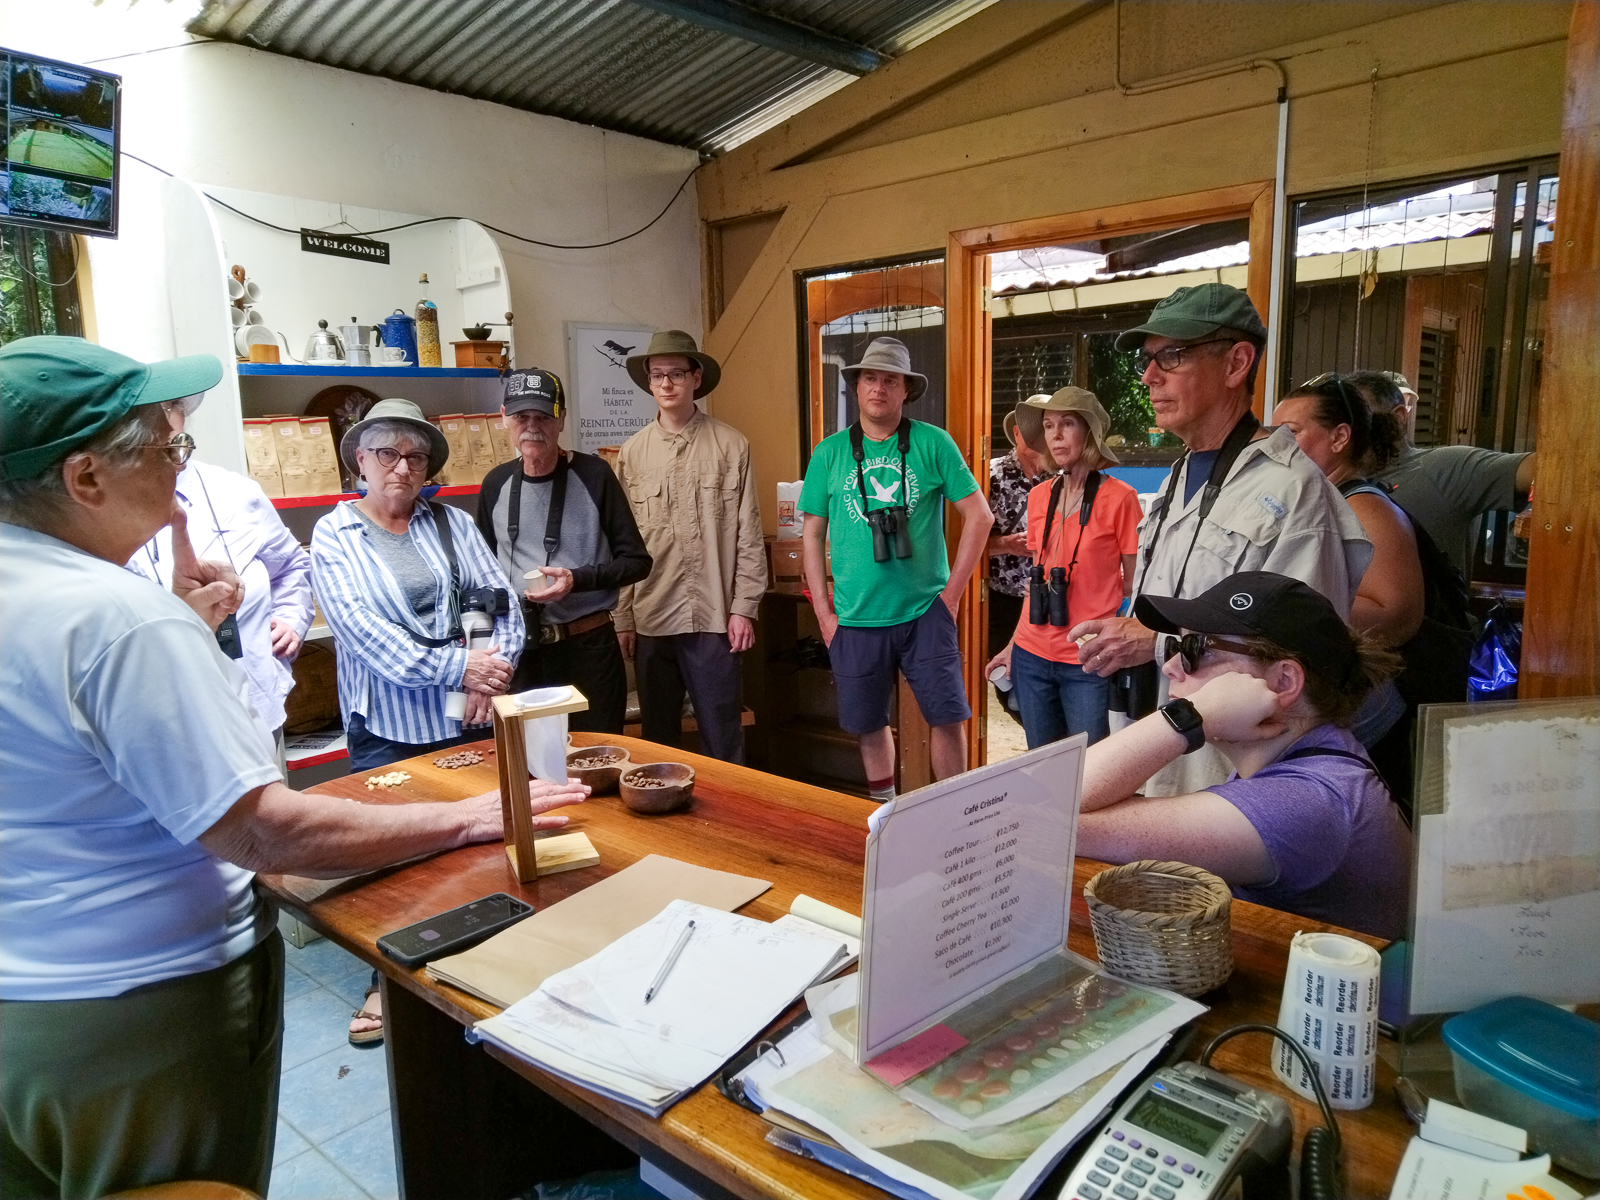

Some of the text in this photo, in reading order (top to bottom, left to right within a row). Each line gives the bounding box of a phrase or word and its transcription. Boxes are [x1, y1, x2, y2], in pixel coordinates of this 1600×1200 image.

[306, 236, 386, 257] WELCOME
[602, 387, 610, 395] Mi
[611, 387, 626, 395] finca
[603, 398, 633, 407] HÁBITAT
[580, 418, 616, 428] REINITA
[585, 430, 593, 438] de
[843, 493, 861, 524] LONG
[865, 455, 889, 466] BIRD
[964, 803, 979, 815] Café
[944, 846, 965, 859] Coffee
[965, 839, 980, 850] Tour
[944, 863, 959, 875] Café
[960, 860, 964, 868] 1
[964, 856, 976, 866] kilo
[943, 878, 957, 891] Café
[957, 873, 969, 885] 400
[969, 869, 982, 881] gms
[941, 895, 956, 908] Café
[956, 889, 968, 902] 200
[967, 885, 981, 897] gms
[942, 909, 960, 923] Single
[960, 901, 977, 915] Serve
[935, 927, 956, 942] Coffee
[956, 917, 976, 931] Cherry
[976, 912, 988, 921] Tea
[934, 946, 949, 959] Saco
[949, 941, 957, 951] de
[958, 933, 972, 946] Café
[945, 949, 974, 969] Chocolate
[1304, 969, 1314, 1005] Reorder
[1335, 978, 1347, 1013] Reorder
[1302, 1012, 1312, 1047] Reorder
[1333, 1021, 1345, 1057] Reorder
[1300, 1064, 1309, 1089] Reor
[1331, 1064, 1342, 1100] Reorder
